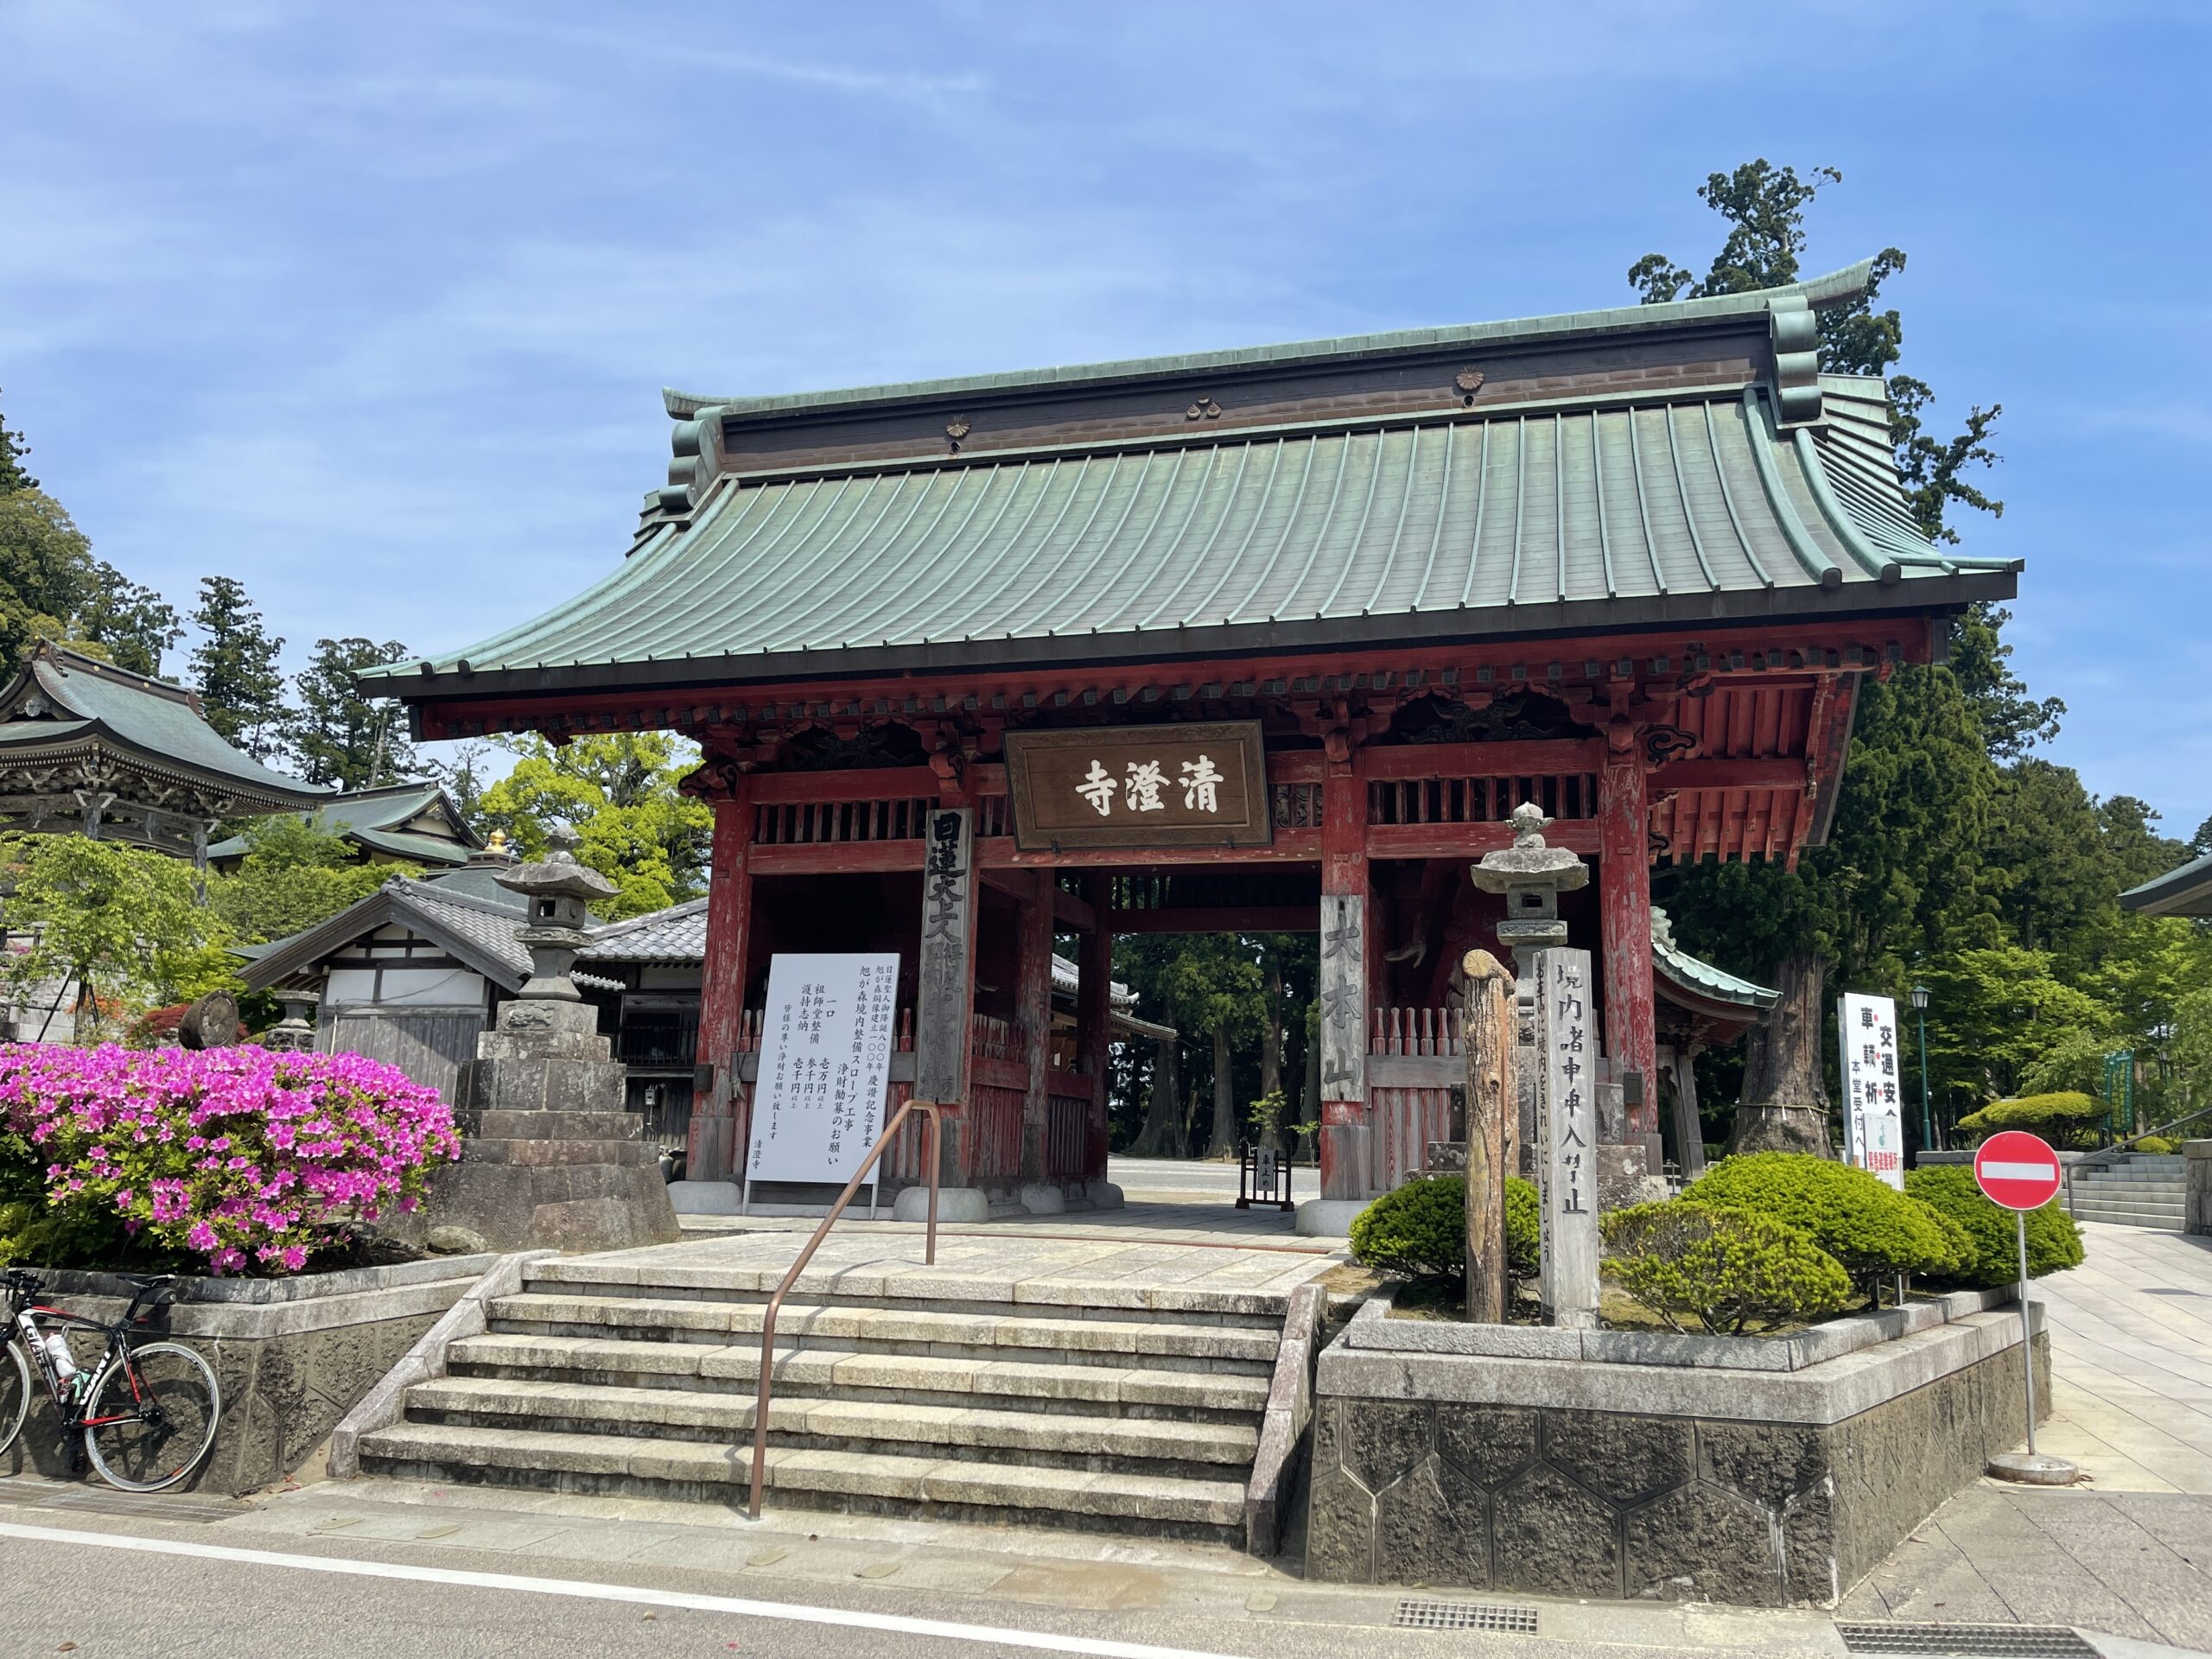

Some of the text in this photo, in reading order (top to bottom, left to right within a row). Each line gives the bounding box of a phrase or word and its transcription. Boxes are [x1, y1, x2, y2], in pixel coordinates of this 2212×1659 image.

[1075, 754, 1224, 817] 清澄寺
[1321, 912, 1363, 1086] 大本山
